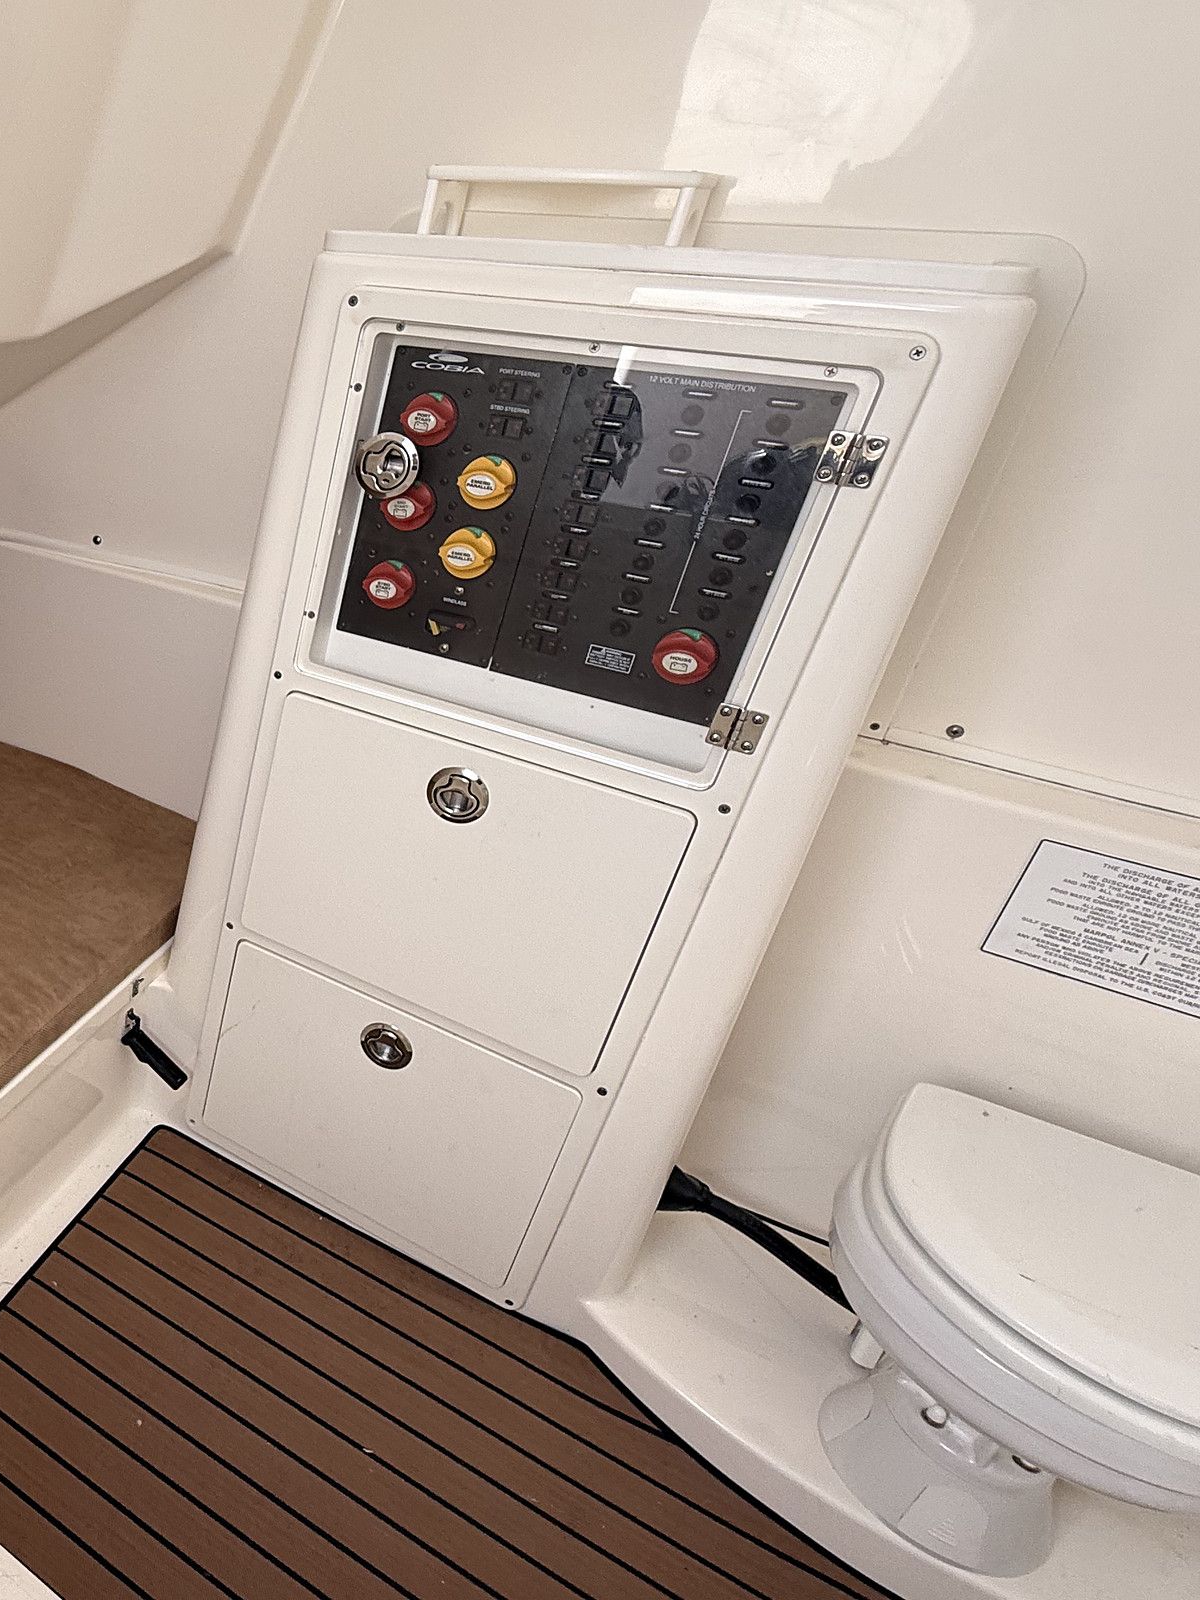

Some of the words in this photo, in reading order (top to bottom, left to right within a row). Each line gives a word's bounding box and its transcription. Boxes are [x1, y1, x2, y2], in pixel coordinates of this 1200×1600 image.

[411, 361, 485, 375] COBIA
[659, 376, 679, 385] VOLT
[680, 378, 701, 387] MAIN
[701, 380, 757, 393] DISTRIBUTION
[670, 655, 692, 663] HOUSE
[1102, 863, 1120, 871] THE
[1122, 868, 1174, 885] DISCHARGE
[1117, 873, 1139, 882] INTO
[1141, 879, 1161, 888] ALL
[1081, 872, 1099, 880] THE
[1101, 877, 1153, 895] DISCHARGE
[1156, 891, 1169, 899] OF
[1171, 895, 1191, 905] ALL
[1082, 927, 1118, 941] MARPOL
